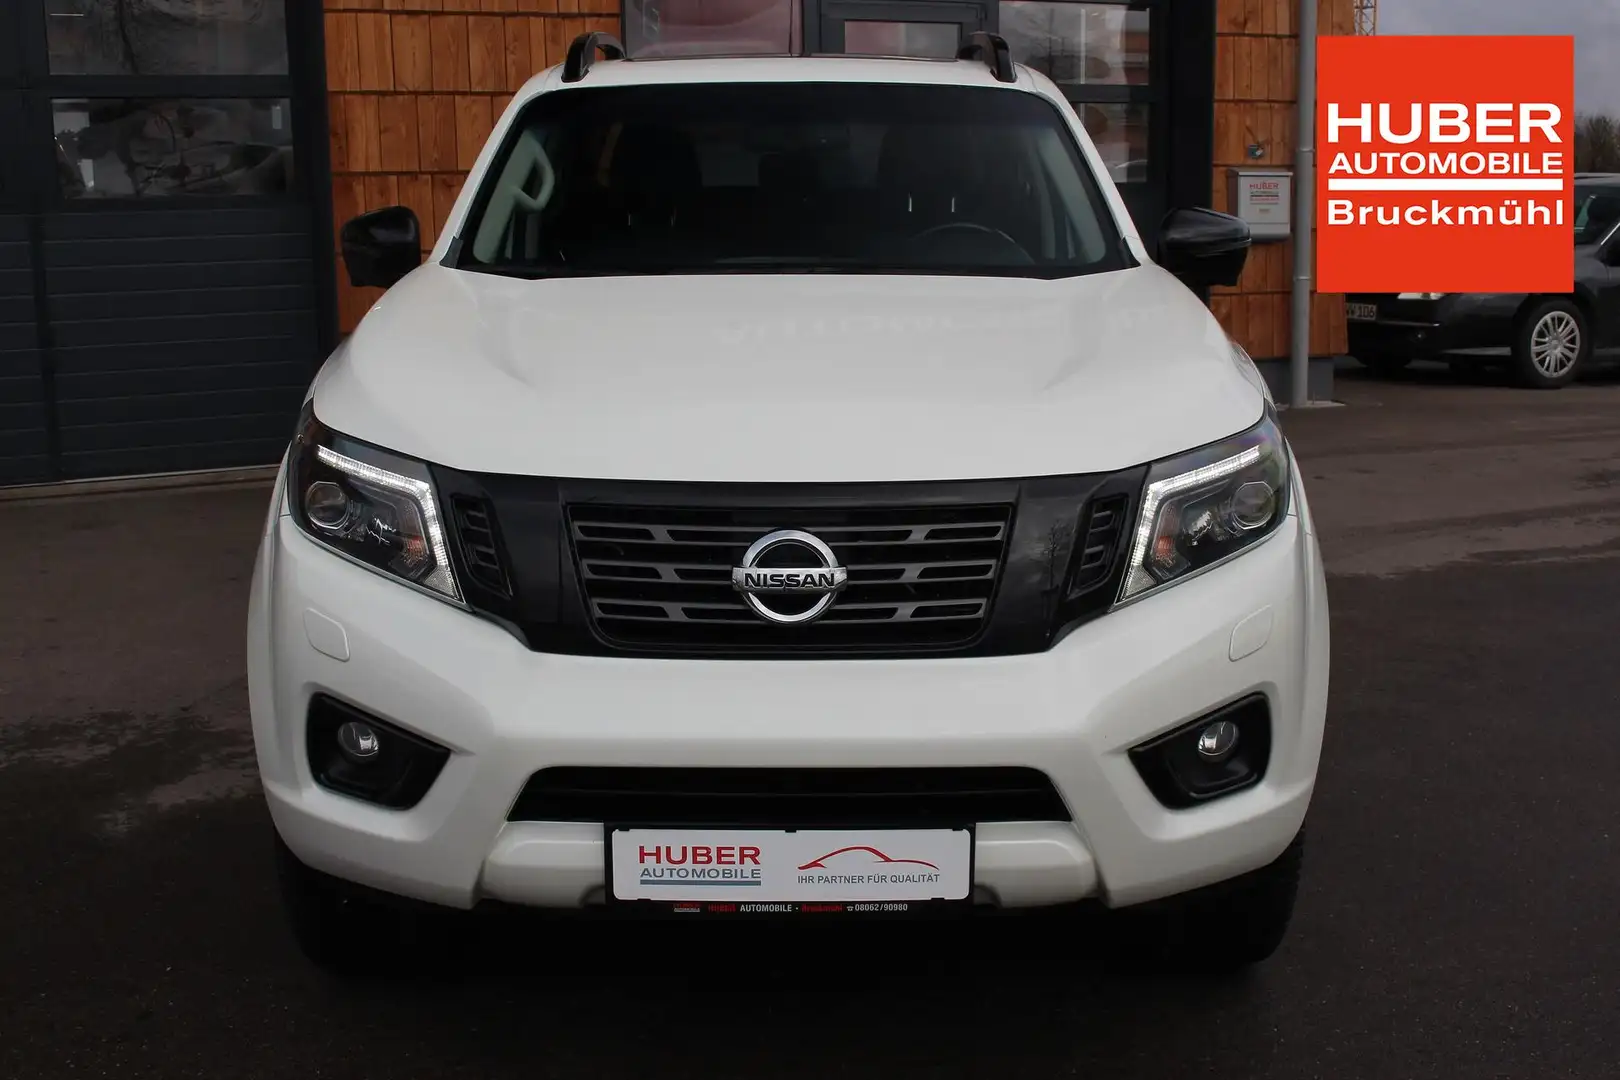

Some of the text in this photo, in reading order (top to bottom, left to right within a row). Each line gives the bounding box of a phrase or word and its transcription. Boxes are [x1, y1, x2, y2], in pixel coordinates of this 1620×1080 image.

[744, 573, 835, 588] NISSAN
[639, 846, 761, 865] HUBER
[640, 868, 761, 879] AUTOMOBILE
[797, 873, 940, 884] IHR PARTNER FÜR QUALITÄT
[740, 903, 793, 912] AUTOMOBILE
[854, 903, 908, 911] 08062/90980
